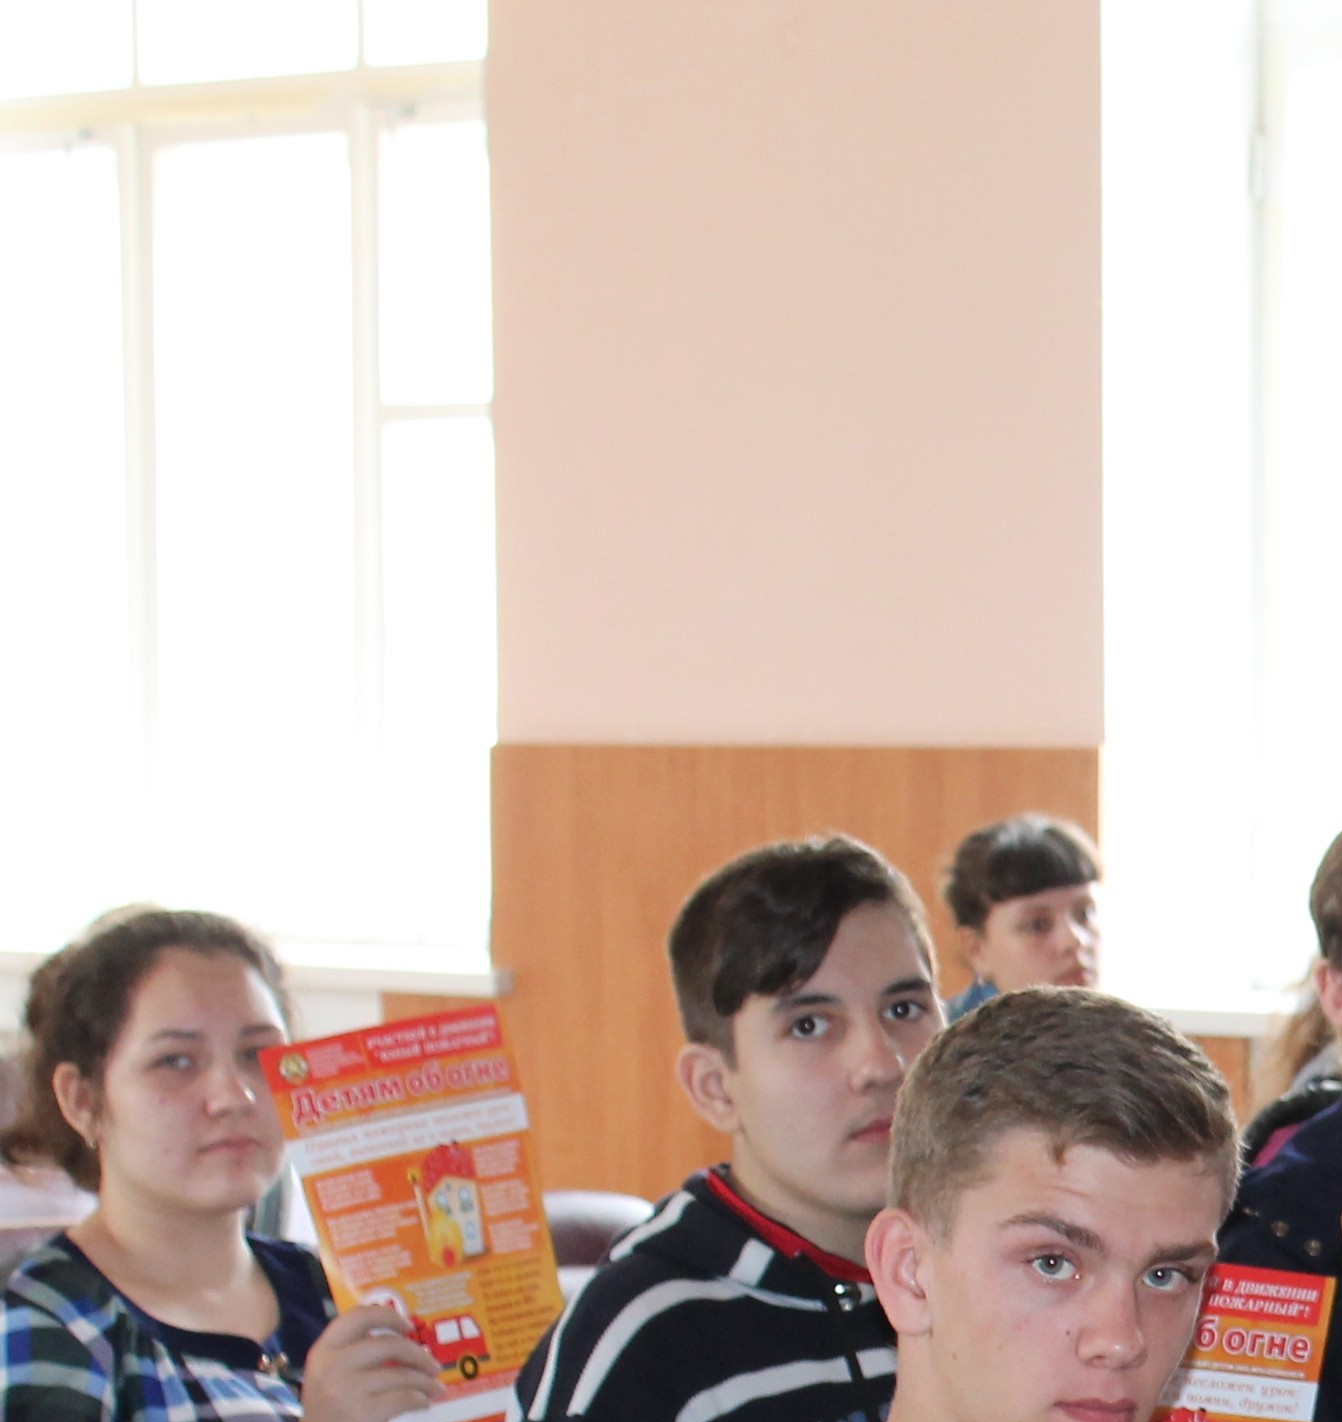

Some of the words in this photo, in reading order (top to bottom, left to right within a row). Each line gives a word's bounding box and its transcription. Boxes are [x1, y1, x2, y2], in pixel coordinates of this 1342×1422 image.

[289, 1078, 406, 1132] Детям
[406, 1060, 447, 1098] об
[449, 1057, 511, 1088] огне
[1194, 1314, 1219, 1350] б
[1222, 1326, 1311, 1363] огне
